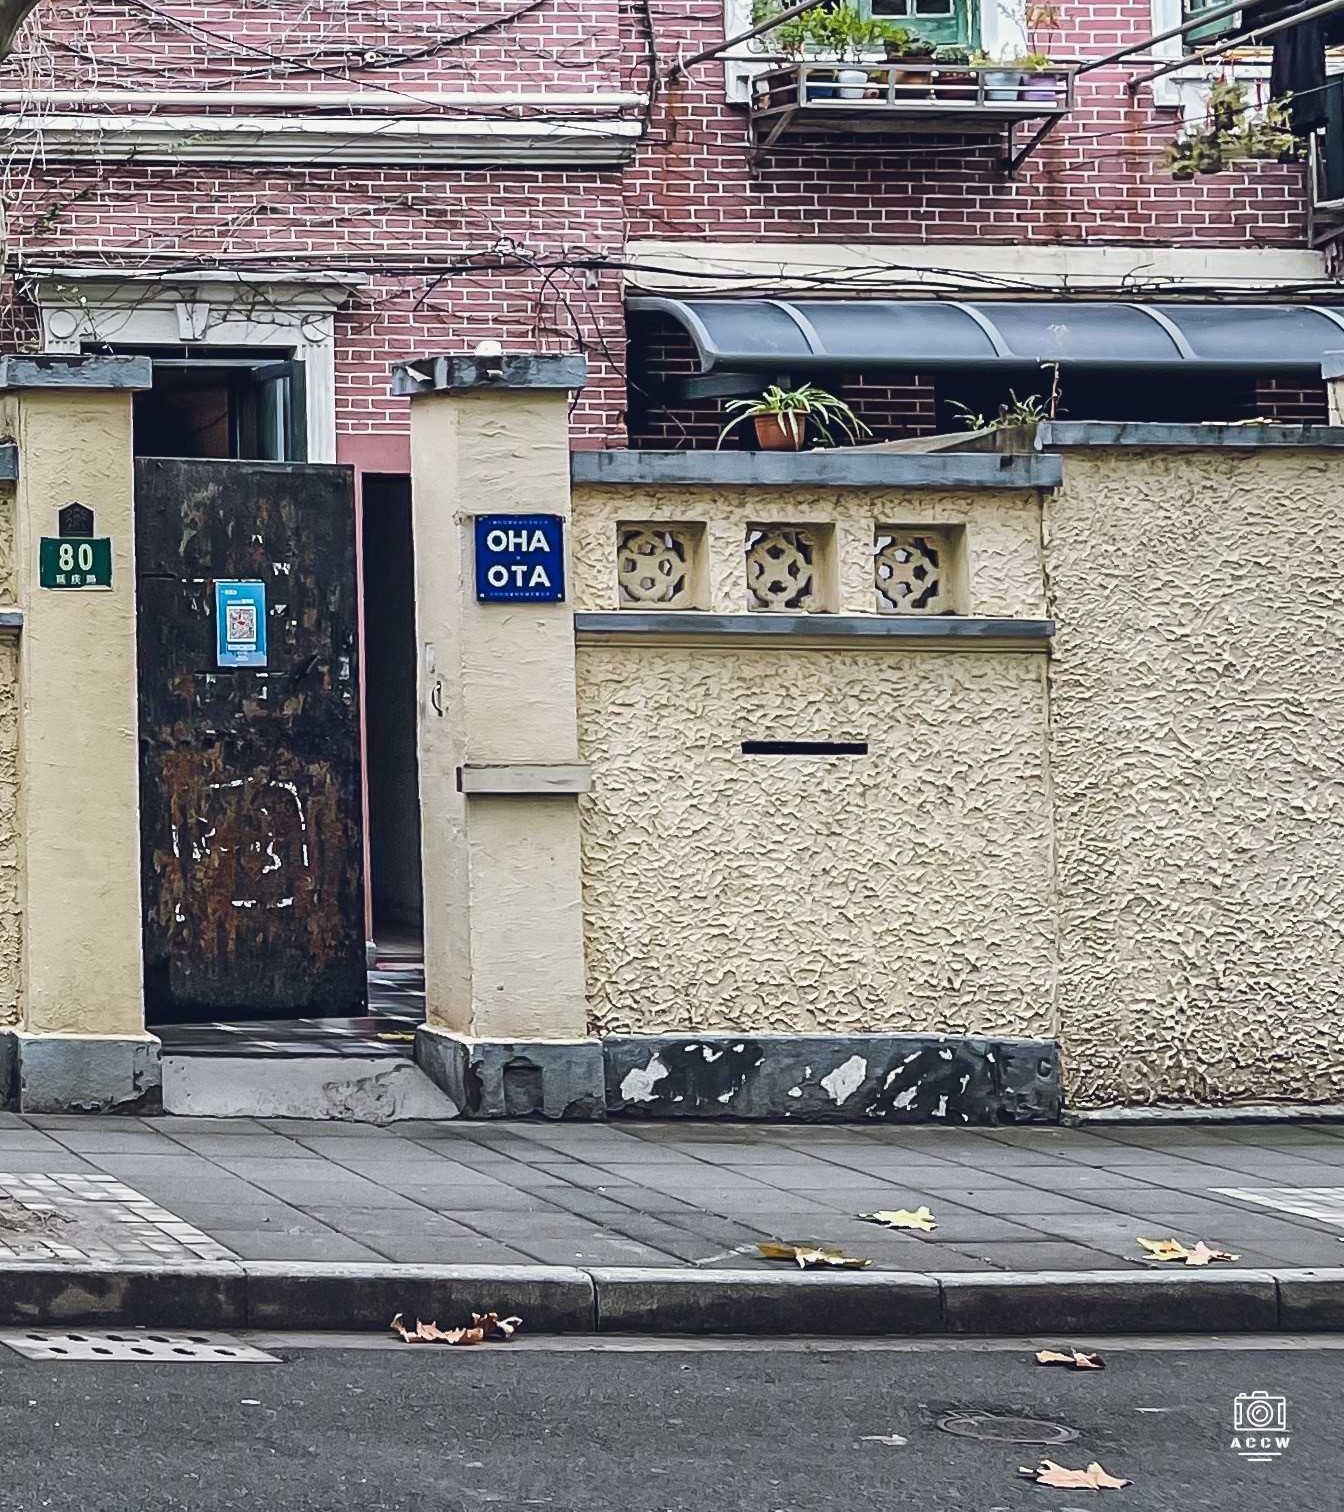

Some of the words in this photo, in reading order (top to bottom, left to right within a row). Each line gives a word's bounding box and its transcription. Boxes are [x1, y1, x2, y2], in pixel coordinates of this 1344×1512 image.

[486, 529, 551, 552] OHA
[58, 543, 93, 571] 80
[487, 565, 551, 588] OTA
